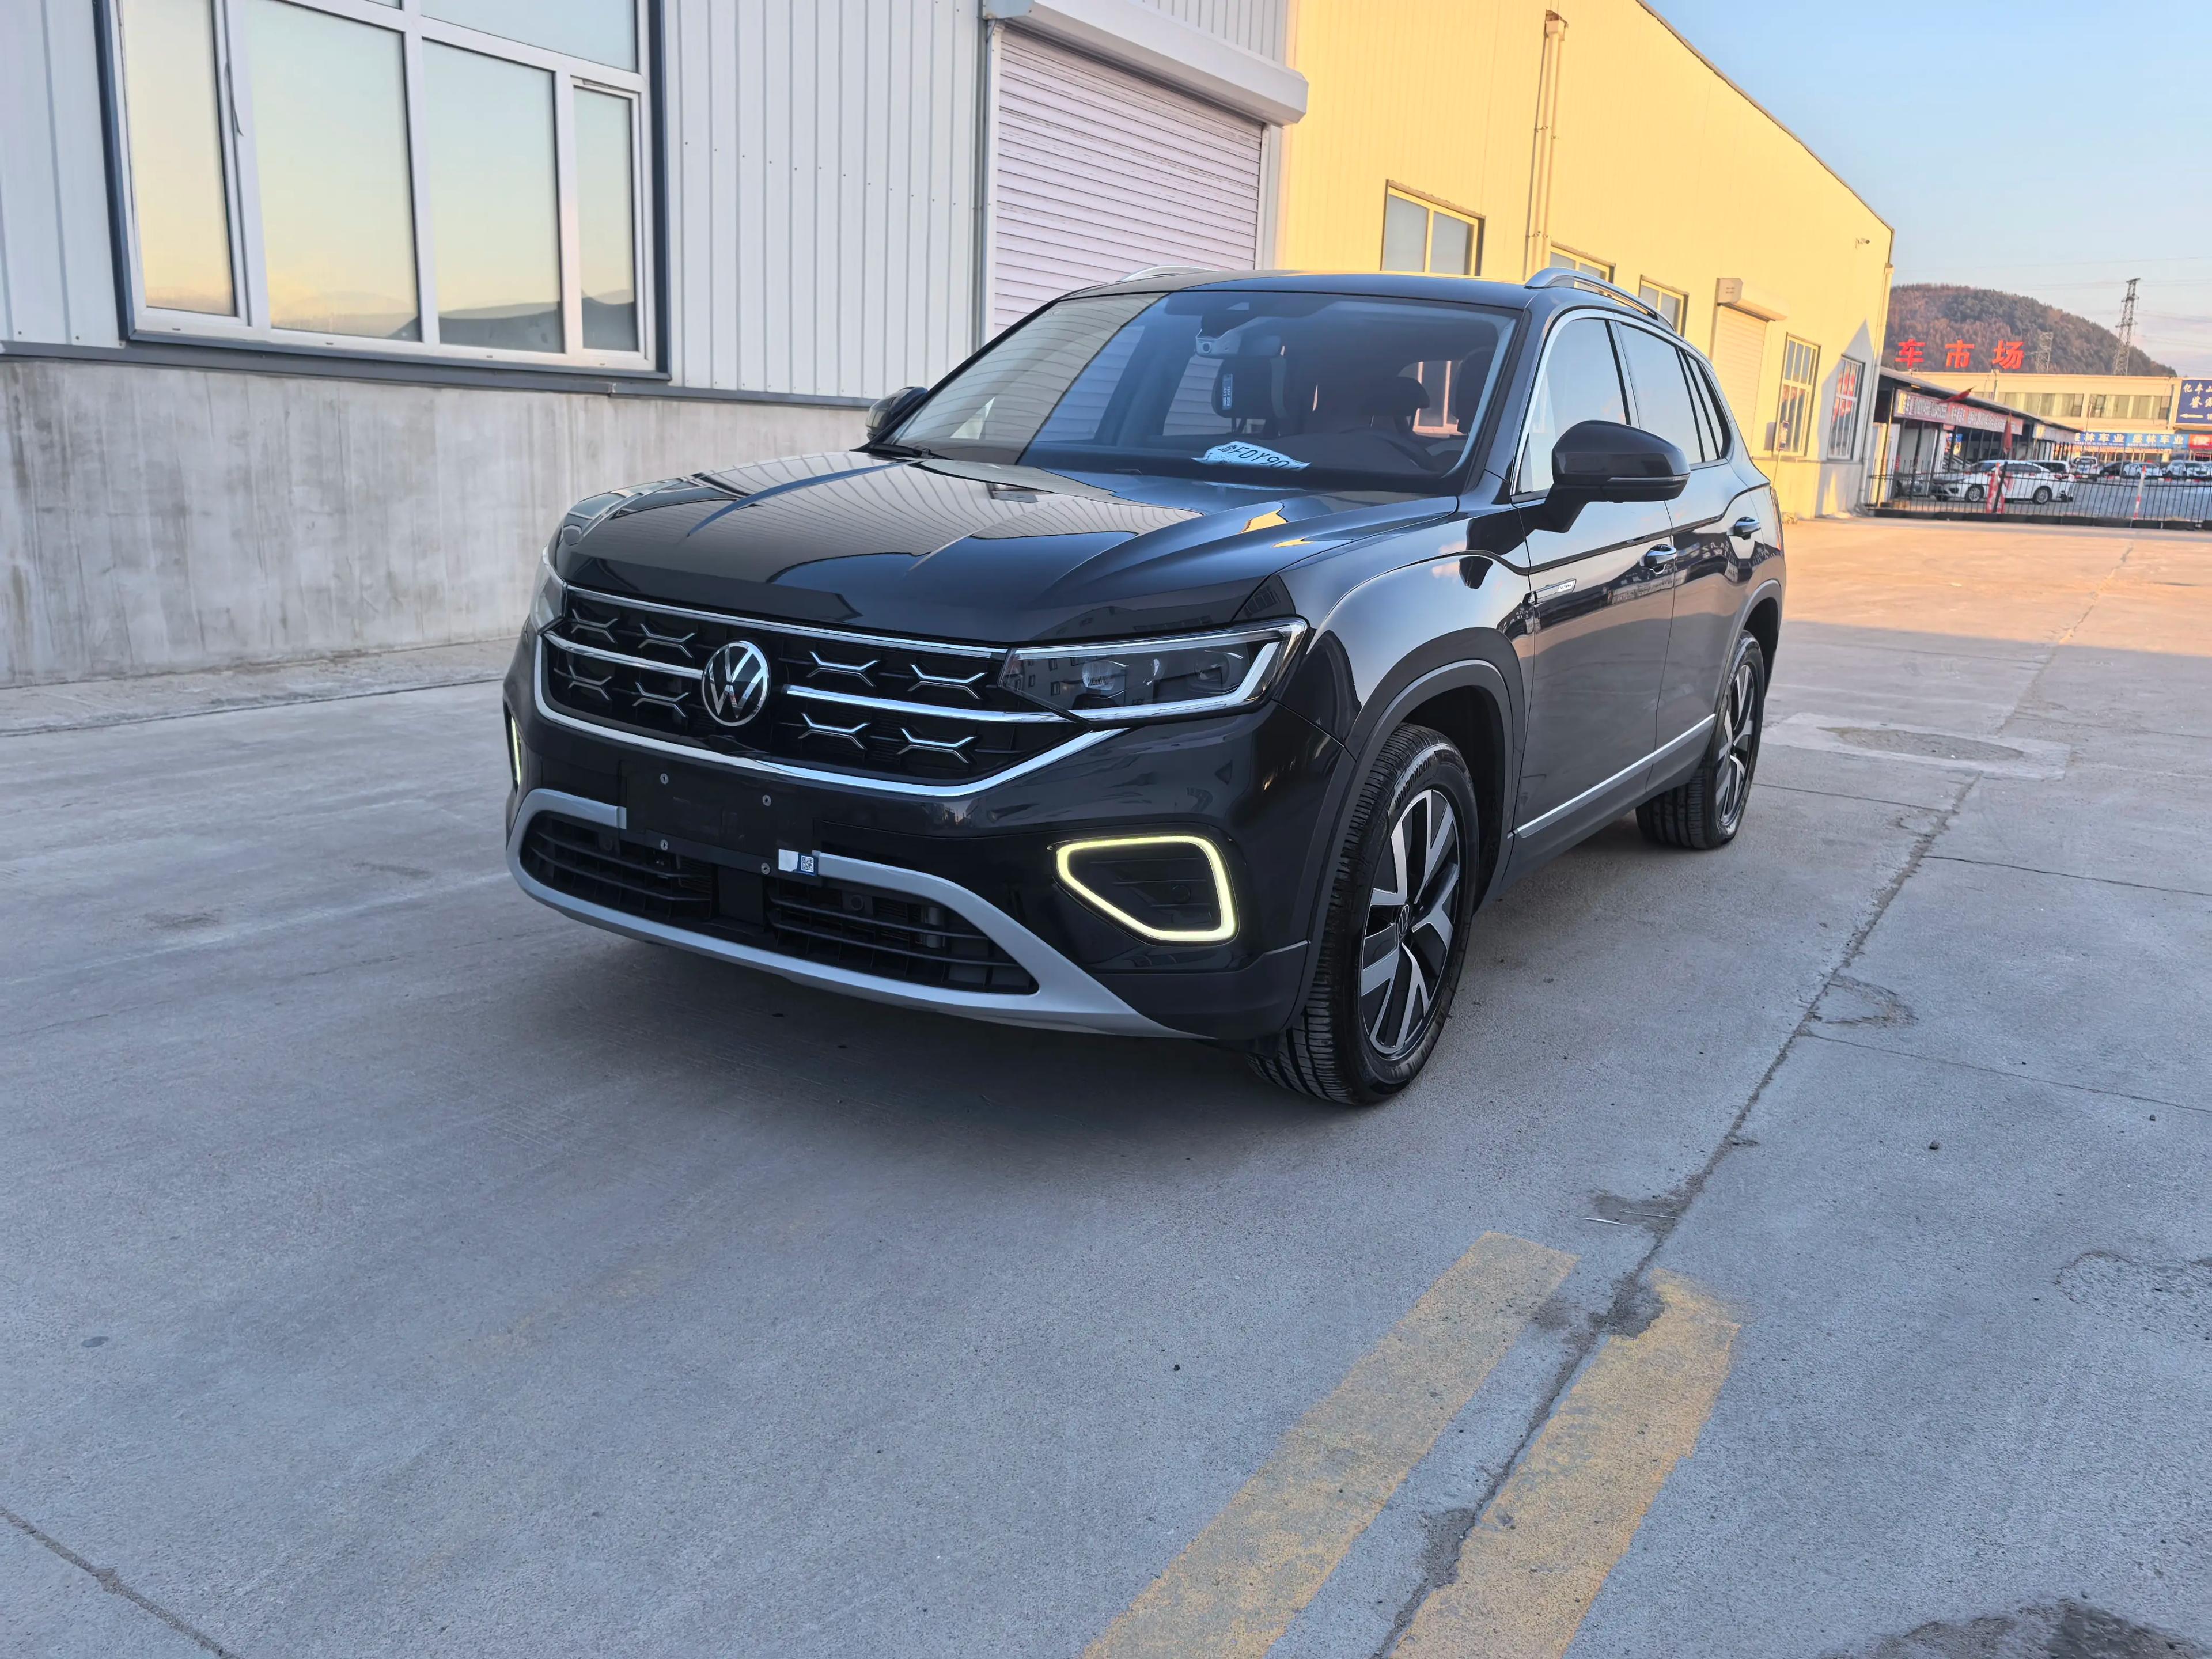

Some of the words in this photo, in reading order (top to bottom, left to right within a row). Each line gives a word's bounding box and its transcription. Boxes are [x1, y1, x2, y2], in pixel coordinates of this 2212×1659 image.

[1895, 338, 2025, 369] 车市场
[703, 641, 770, 726] VW
